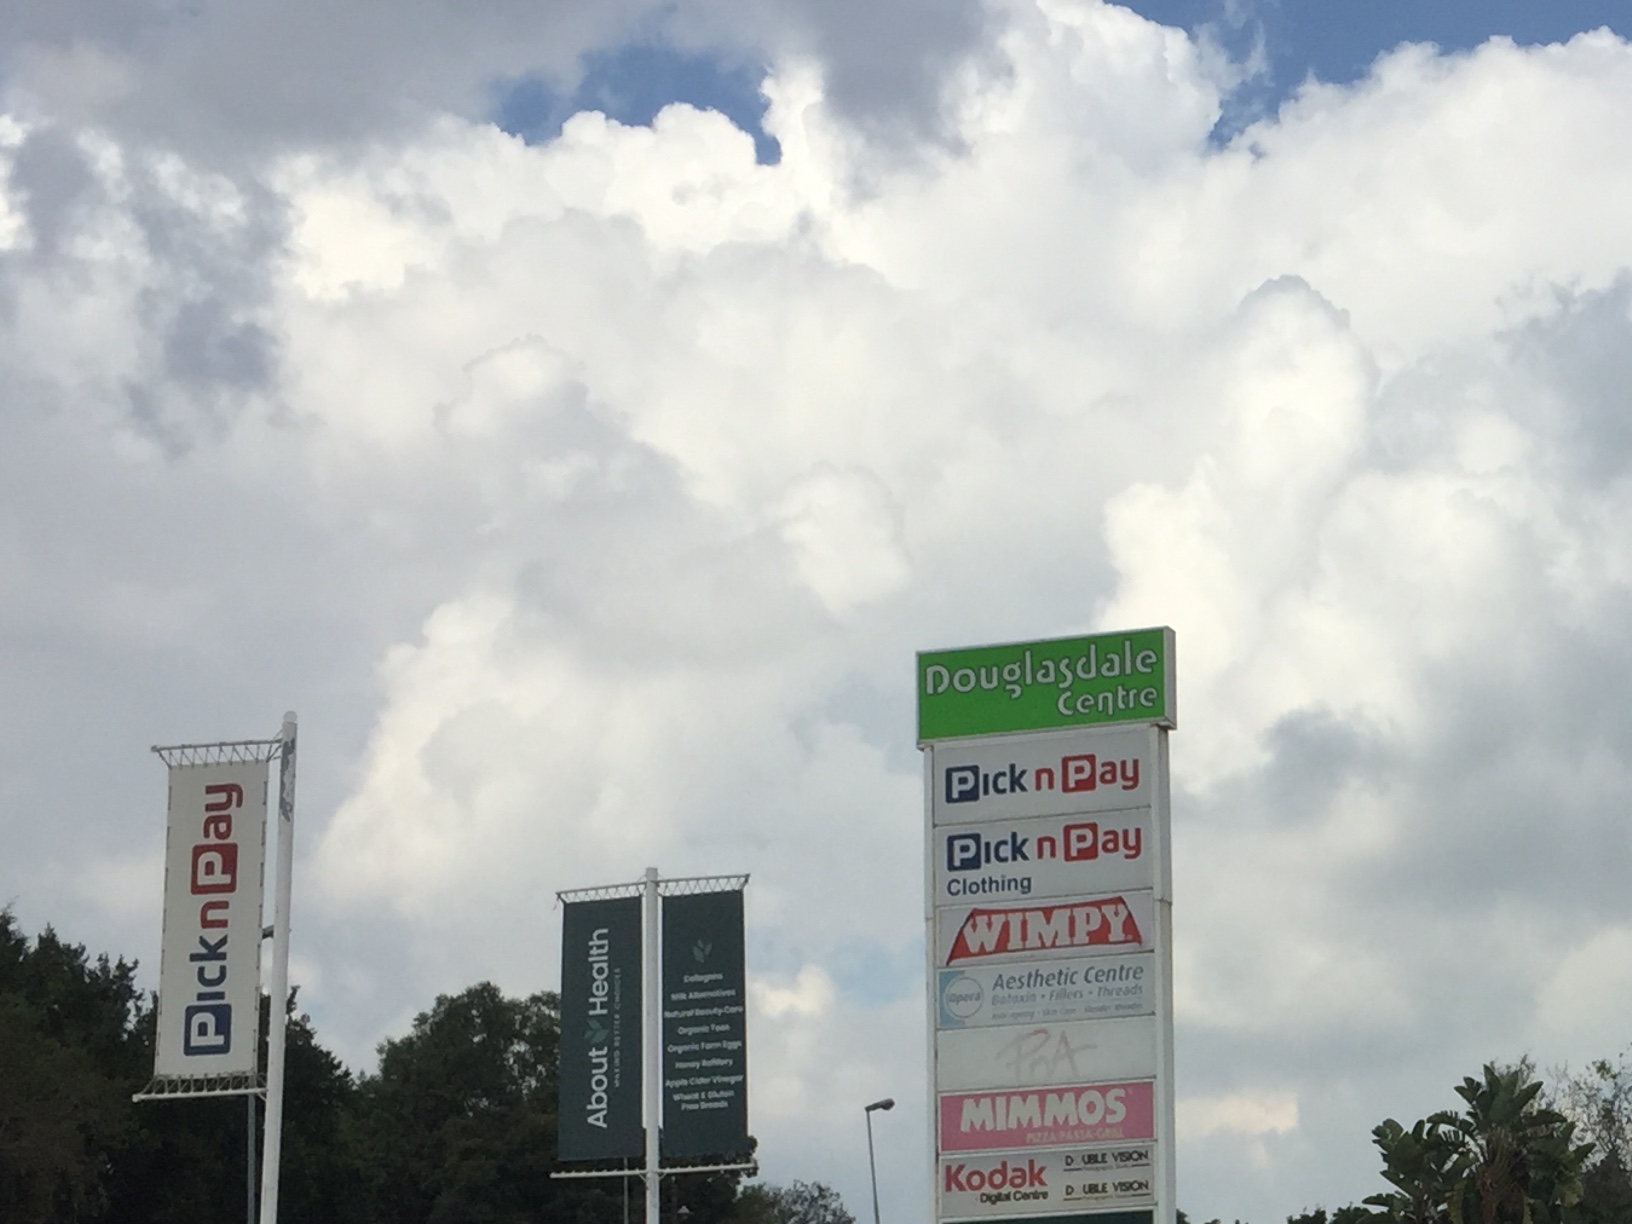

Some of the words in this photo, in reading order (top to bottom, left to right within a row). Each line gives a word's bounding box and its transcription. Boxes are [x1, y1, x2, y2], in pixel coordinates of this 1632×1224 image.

[925, 640, 1159, 699] Douglasdale
[1057, 684, 1158, 716] Centre
[945, 763, 1028, 804] Pick
[1035, 767, 1055, 791] n
[1061, 753, 1140, 793] Pay
[946, 831, 1030, 873] Pick
[1036, 835, 1057, 859] n
[1063, 822, 1142, 862] Pay
[946, 875, 1032, 896] Clothing
[962, 902, 1130, 954] WIMPY
[587, 927, 609, 1016] Health
[991, 967, 1078, 991] Aesthetic
[1083, 965, 1145, 985] Centre
[1097, 984, 1144, 998] Threads
[586, 1045, 608, 1129] About
[960, 1087, 1127, 1133] MIMMOS
[1111, 1150, 1149, 1163] VISION
[945, 1159, 1048, 1193] Kodak
[1112, 1180, 1149, 1192] VISION
[1013, 1189, 1049, 1202] Centre
